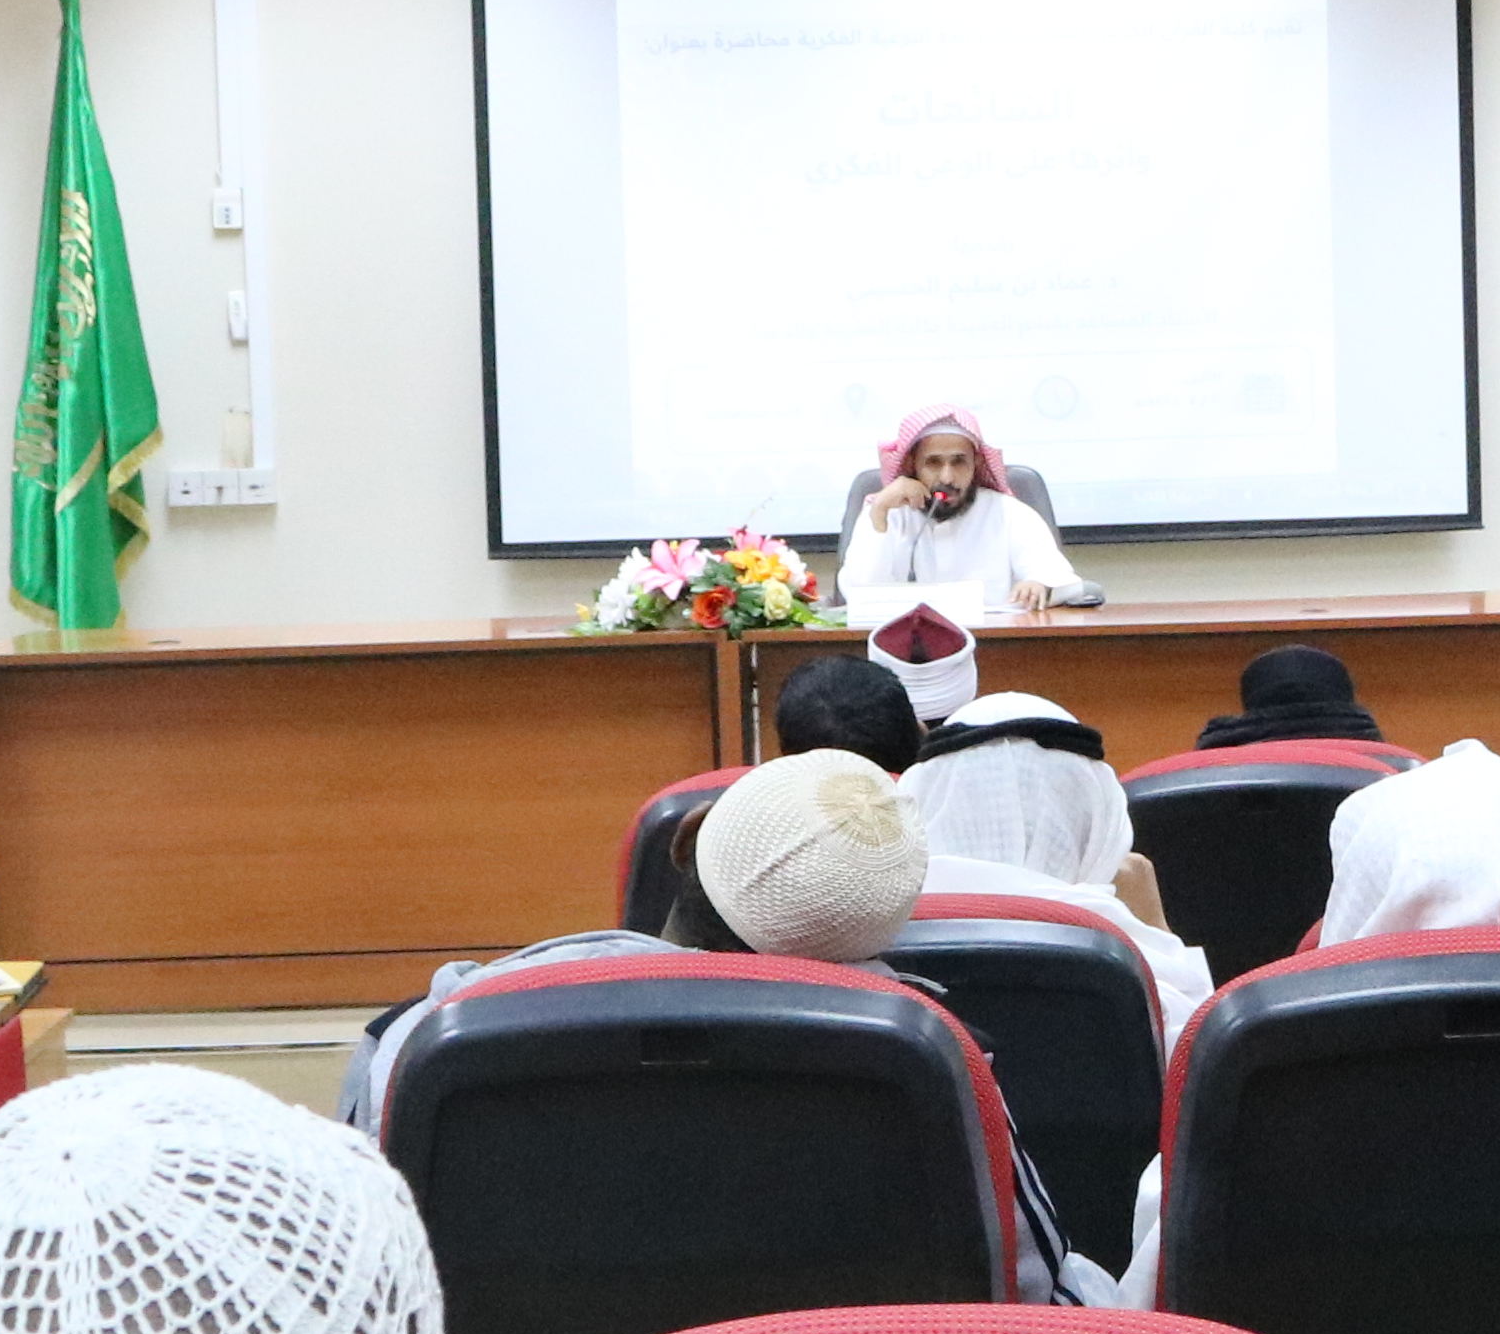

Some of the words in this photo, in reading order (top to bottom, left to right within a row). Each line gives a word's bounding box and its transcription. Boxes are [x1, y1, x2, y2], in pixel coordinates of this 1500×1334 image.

[713, 30, 791, 53] محاضرة
[797, 28, 864, 51] الفكرية
[878, 85, 1075, 126] الشائعات
[804, 150, 902, 194] الفكري
[913, 148, 994, 188] الوعي
[1004, 147, 1057, 180] على
[1070, 137, 1153, 177] وأثرها
